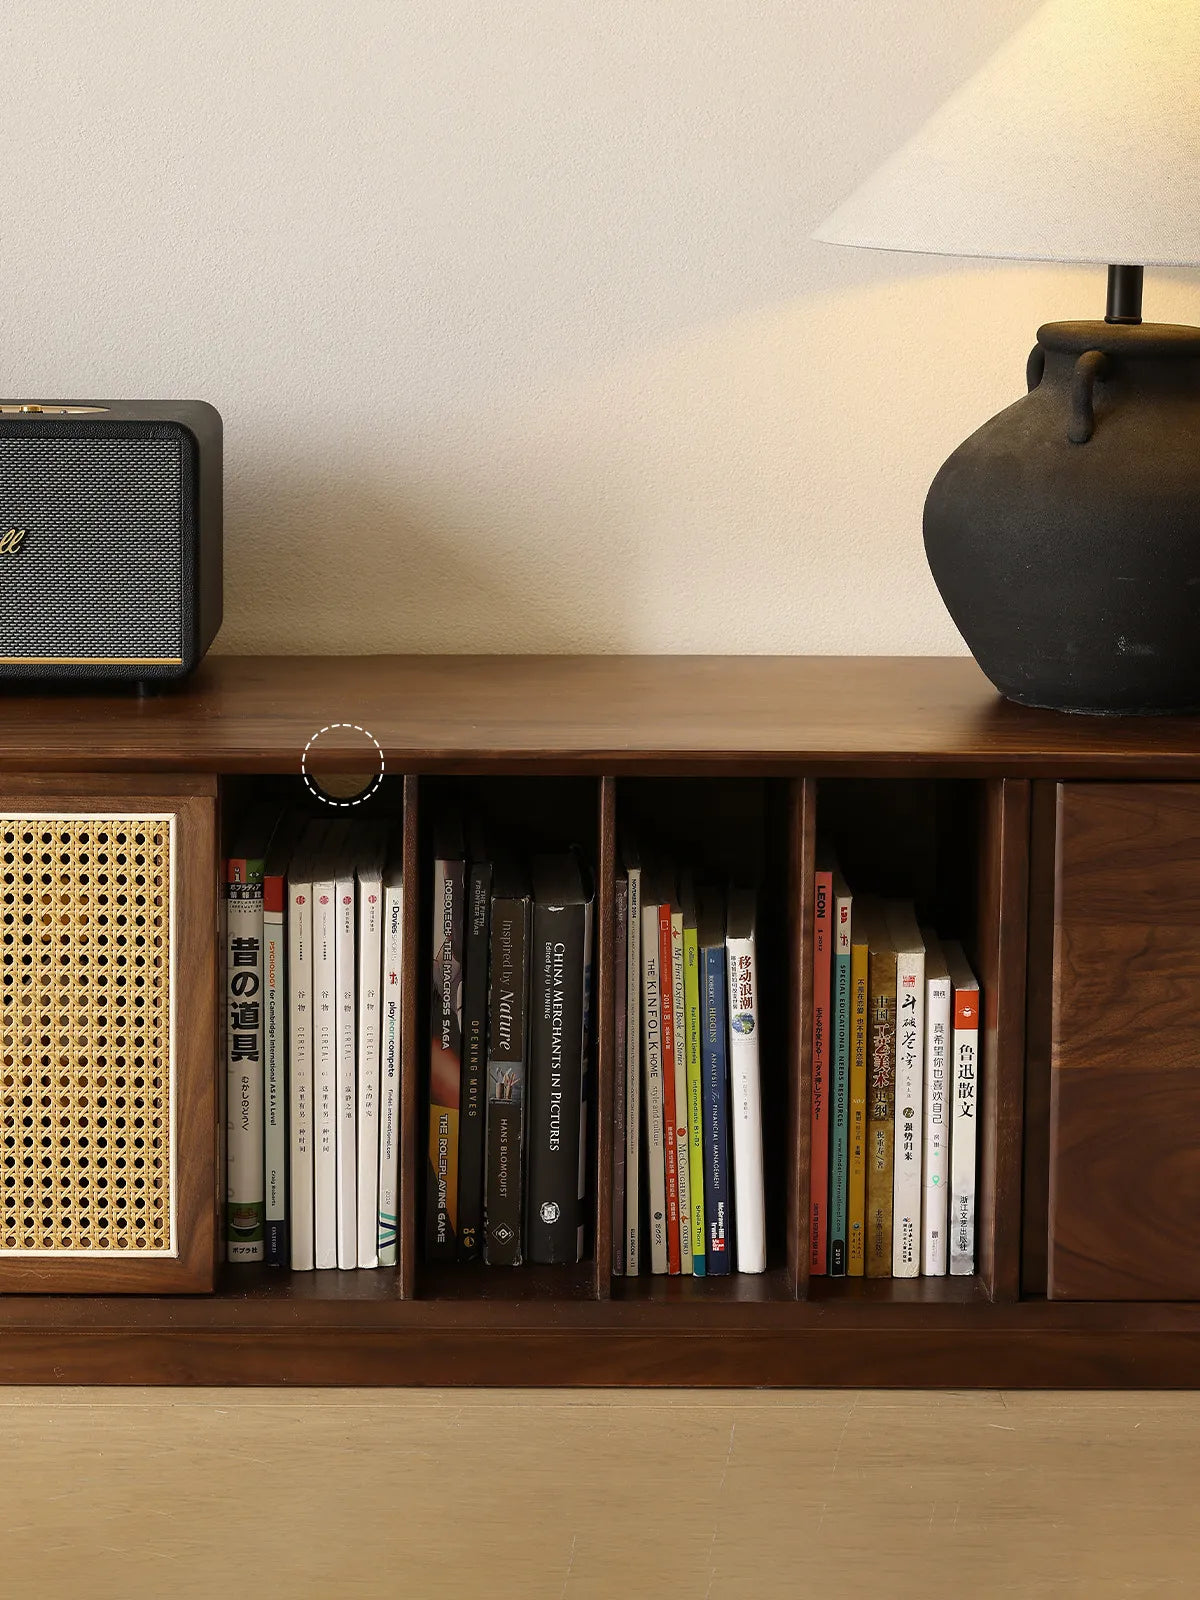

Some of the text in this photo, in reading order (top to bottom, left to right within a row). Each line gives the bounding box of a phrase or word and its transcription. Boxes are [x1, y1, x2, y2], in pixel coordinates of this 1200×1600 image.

[391, 906, 400, 935] Davies
[816, 885, 827, 919] LEON
[441, 879, 453, 1051] ROBOTECH: THE MACROSS SAGA
[543, 964, 552, 974] by
[673, 946, 682, 961] My
[674, 962, 682, 980] First
[230, 937, 260, 1062] 昔の道具
[499, 920, 514, 1051] Inspired by Nature
[675, 982, 684, 1010] Oxford
[739, 955, 753, 1010] 移动浪潮
[268, 1001, 277, 1039] Cambridge
[344, 1024, 352, 1060] CEREAL
[387, 1001, 398, 1078] playlearncompete
[647, 958, 659, 1078] THE KINFOLK HOME
[676, 1011, 684, 1029] Book
[709, 1007, 717, 1043] HIGGINS
[838, 998, 846, 1053] EDUCATIONAL
[901, 993, 917, 1070] 斗破苍穹
[269, 1040, 277, 1082] International
[297, 1026, 305, 1063] CEREAL
[321, 1026, 329, 1063] CEREAL
[366, 1025, 374, 1062] CEREAL
[468, 1020, 479, 1117] OPENING MOVES
[550, 942, 566, 1151] CHINA MERCHANTS IN PICTURES
[677, 1041, 685, 1066] Stories
[872, 995, 891, 1117] 中国工艺美术史纲
[270, 1084, 276, 1094] AS
[932, 1022, 944, 1125] 真希望你也喜欢自己
[957, 1043, 975, 1118] 鲁迅散文
[386, 1088, 394, 1160] findel-international.com
[651, 1085, 661, 1147] style and culture
[837, 1083, 845, 1128] RESOURCES
[498, 1118, 508, 1199] HANS BLOMQUIST
[903, 1122, 913, 1161] 强势归来
[437, 1114, 448, 1243] THE ROLEPLAYING GAME
[835, 1137, 843, 1233] www.findel-international.com
[717, 1201, 725, 1239] McGraw-Hill
[959, 1195, 969, 1252] 浙江文艺出版社
